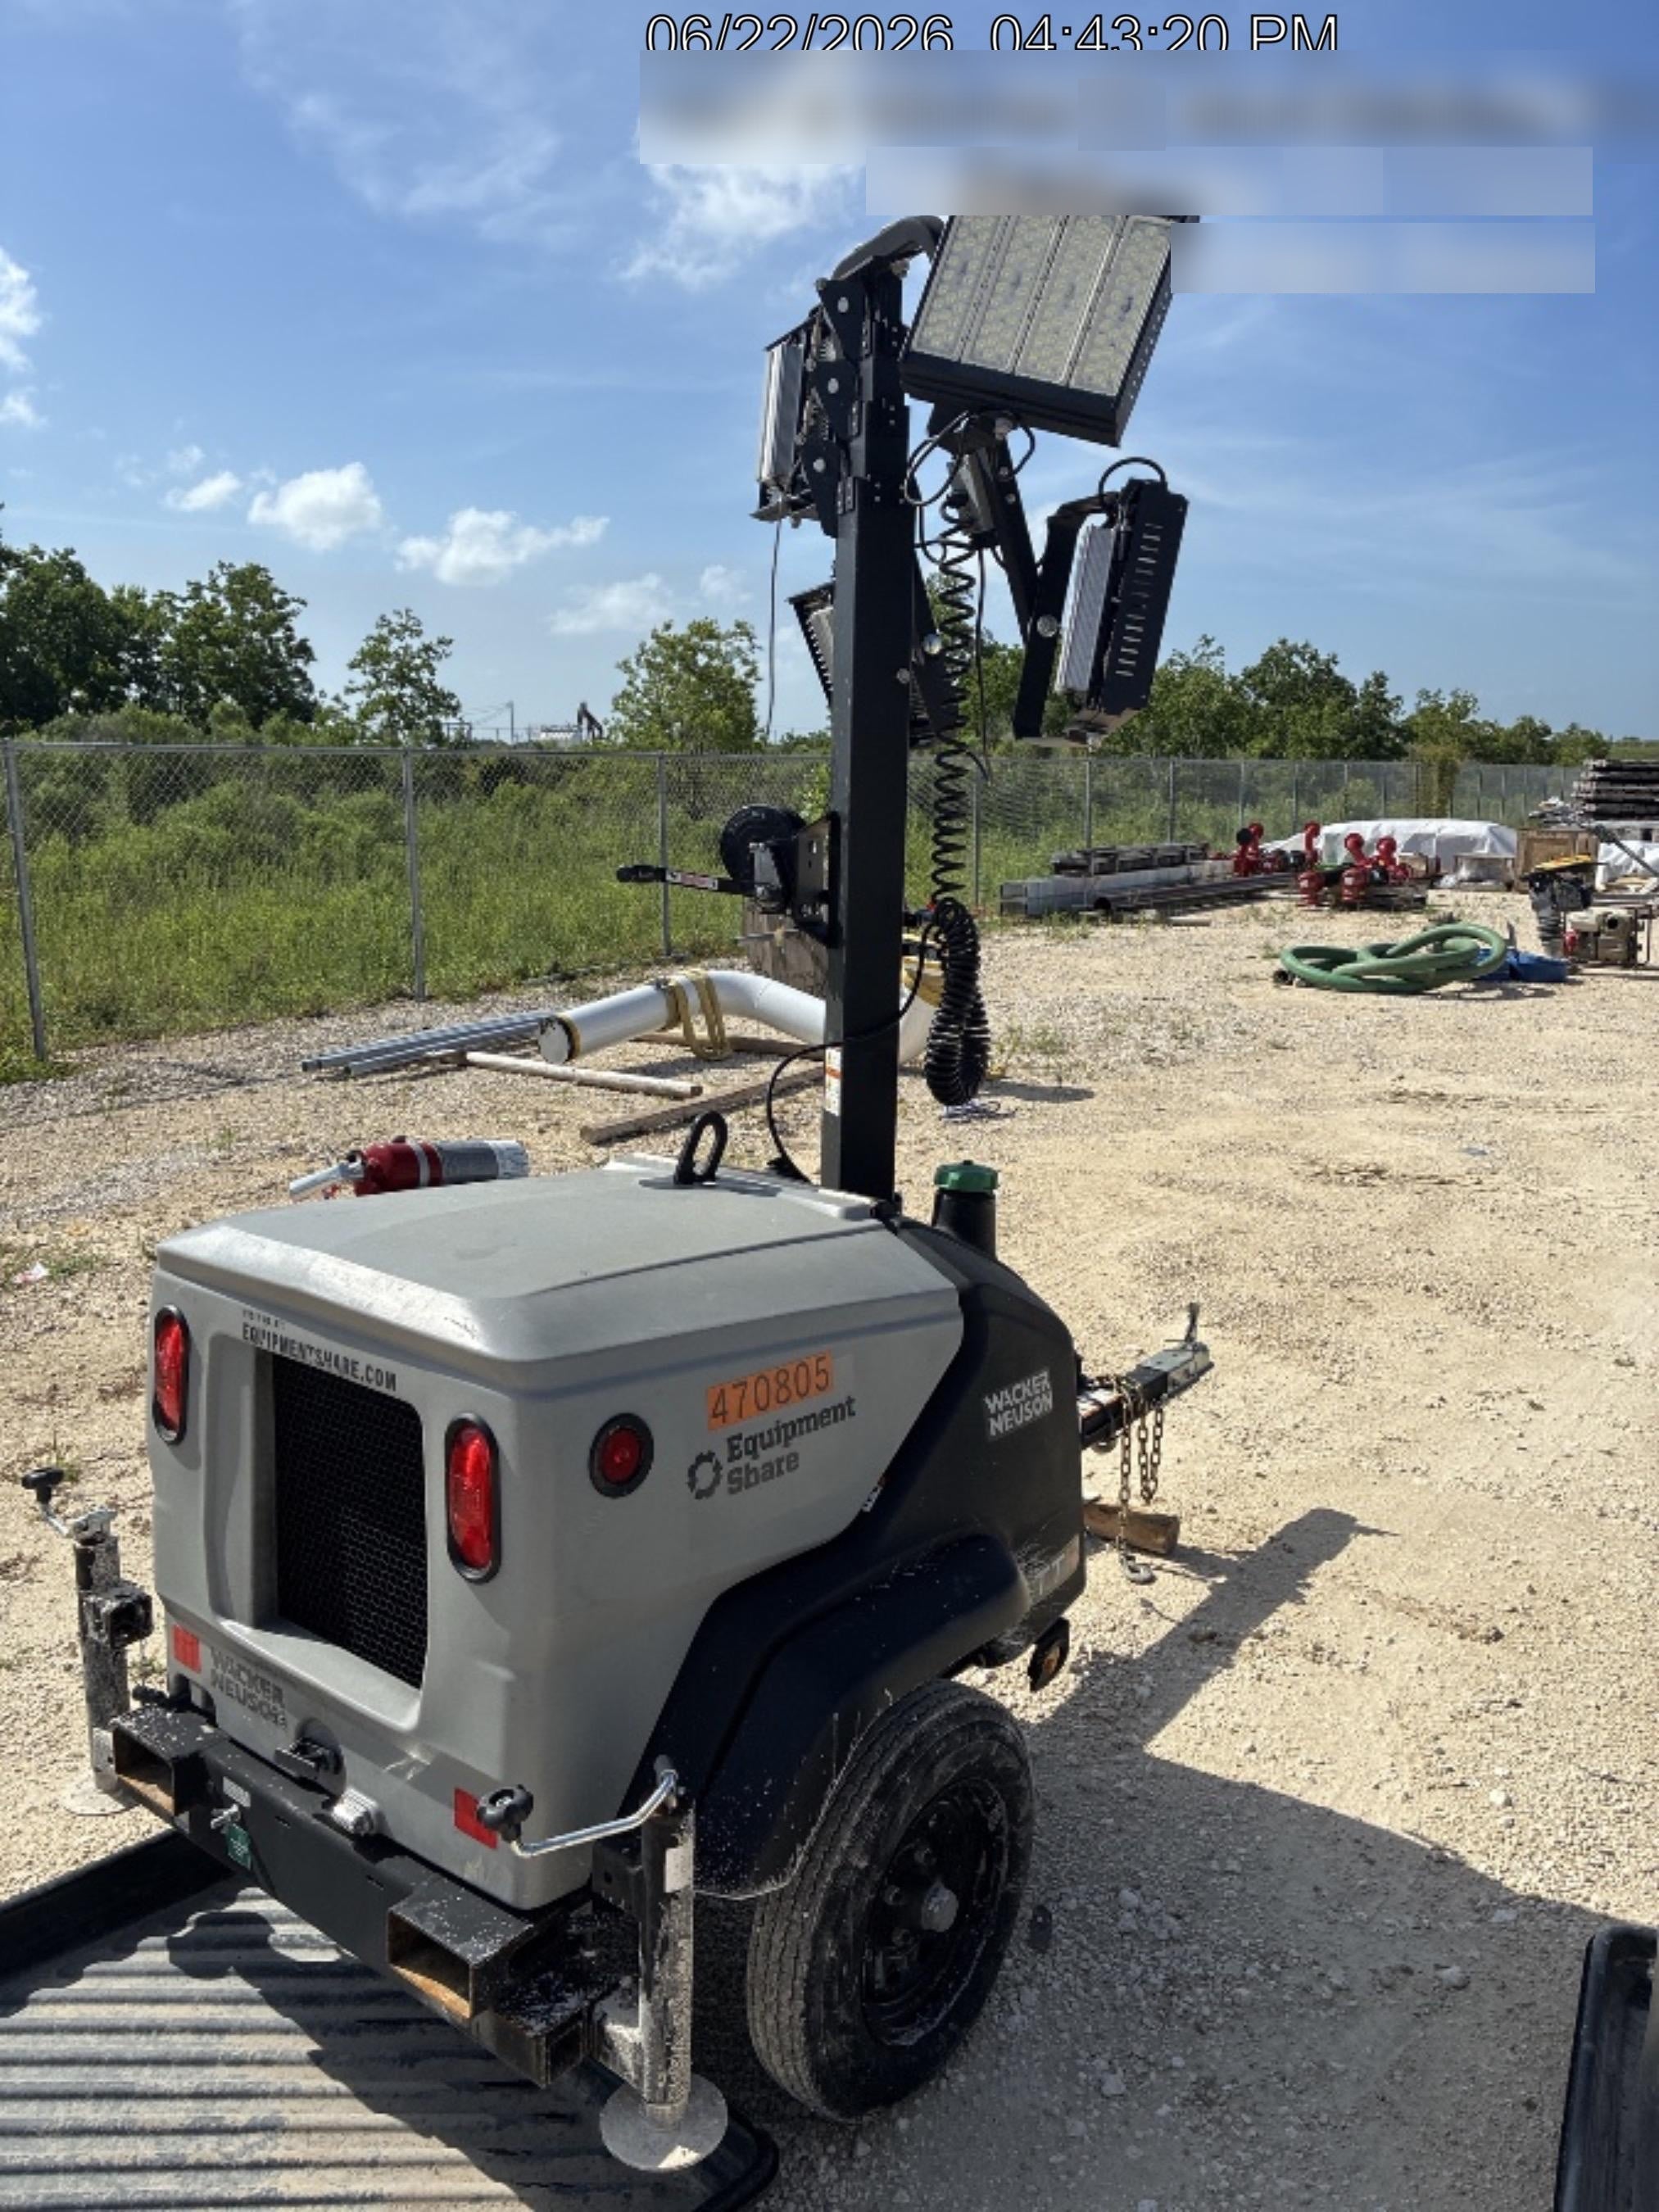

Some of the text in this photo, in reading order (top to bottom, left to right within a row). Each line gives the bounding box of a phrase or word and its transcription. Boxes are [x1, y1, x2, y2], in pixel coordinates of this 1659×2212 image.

[711, 1356, 830, 1424] 470805
[984, 1371, 1049, 1414] WACKER
[989, 1390, 1053, 1436] NEUSON
[727, 1394, 856, 1462] Equipment
[727, 1452, 800, 1495] Share
